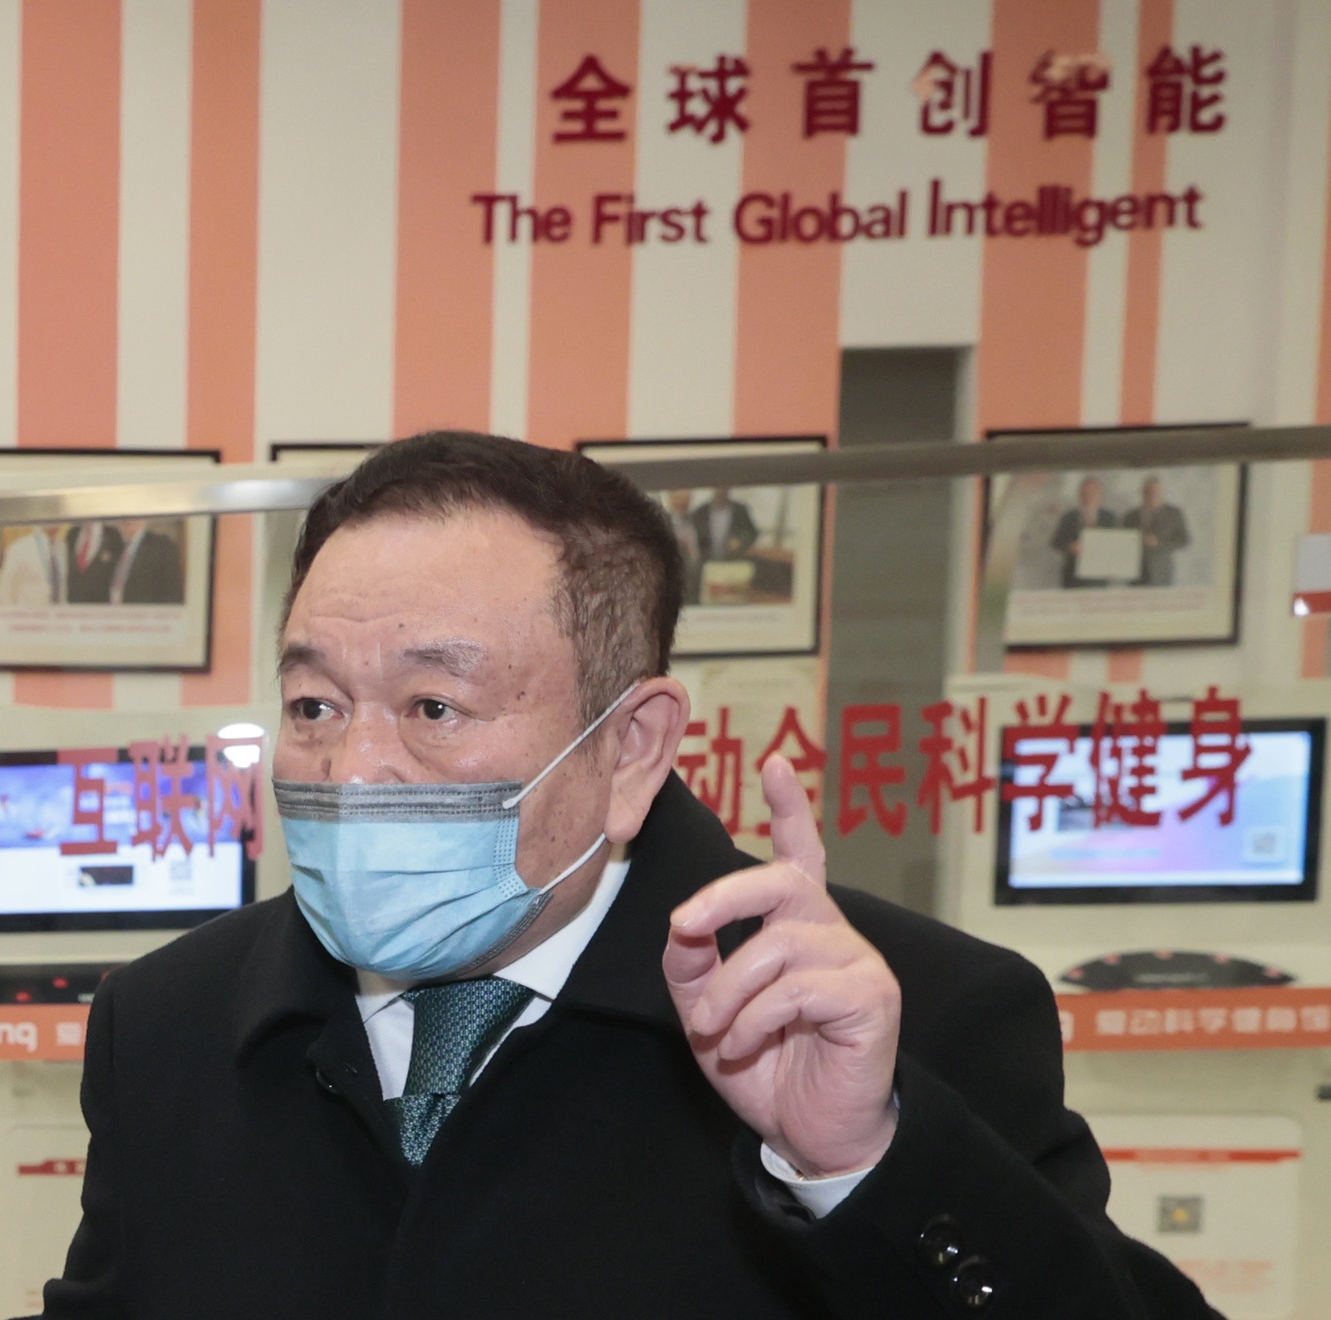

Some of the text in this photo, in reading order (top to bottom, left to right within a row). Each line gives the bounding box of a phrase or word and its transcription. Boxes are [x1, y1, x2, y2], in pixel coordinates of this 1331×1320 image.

[550, 43, 1227, 145] 全球首创智能
[470, 180, 1203, 248] The First Global Intelligent
